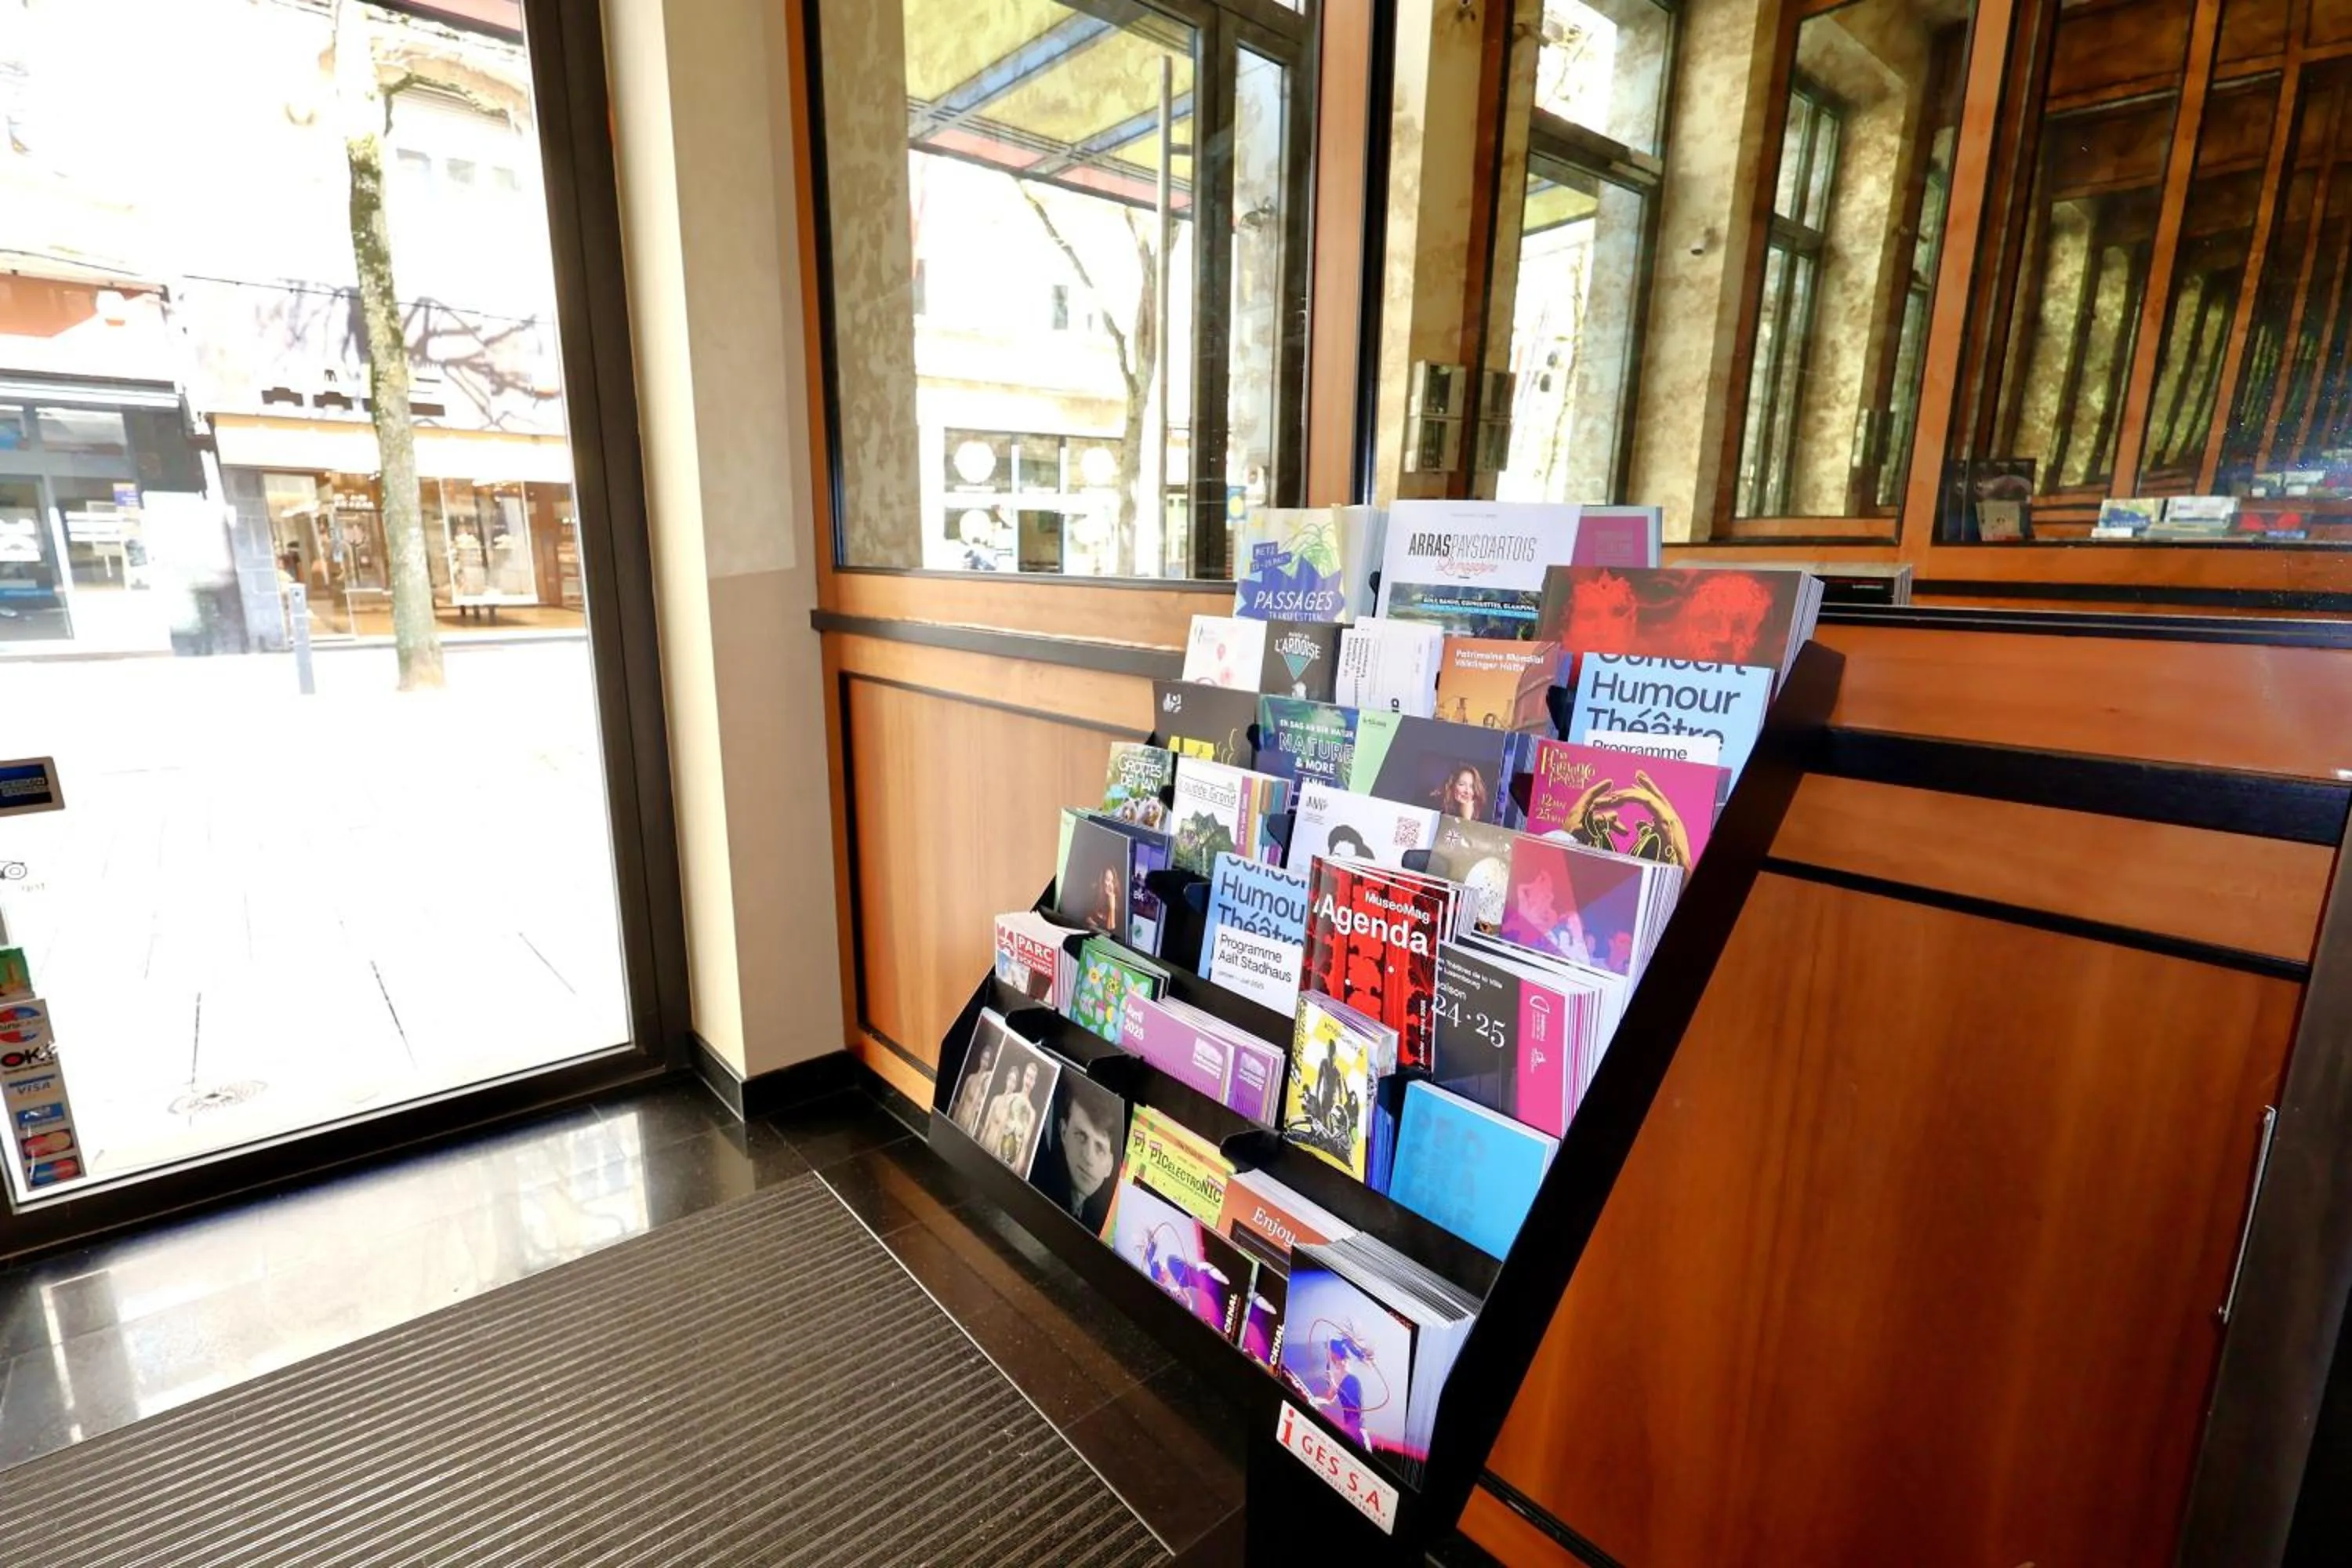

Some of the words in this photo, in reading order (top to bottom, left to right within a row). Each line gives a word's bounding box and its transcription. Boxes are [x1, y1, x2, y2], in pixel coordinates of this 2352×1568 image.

[1254, 590, 1334, 611] PASSAGES
[1274, 636, 1322, 660] L'ARDOISE
[1591, 670, 1741, 715] Humour
[1279, 731, 1355, 764] NATURE
[1305, 759, 1335, 773] MORE
[1220, 871, 1305, 925] Humou
[1365, 891, 1430, 924] MuseoMag
[1218, 902, 1305, 946] Théâtr
[1018, 936, 1054, 963] PARC
[1221, 934, 1282, 962] Programme
[1240, 956, 1292, 983] Stadhaus
[1436, 981, 1468, 1002] aison
[17, 1081, 51, 1095] VISA
[1251, 1207, 1296, 1248] Enjoy
[1301, 1435, 1340, 1476] GES
